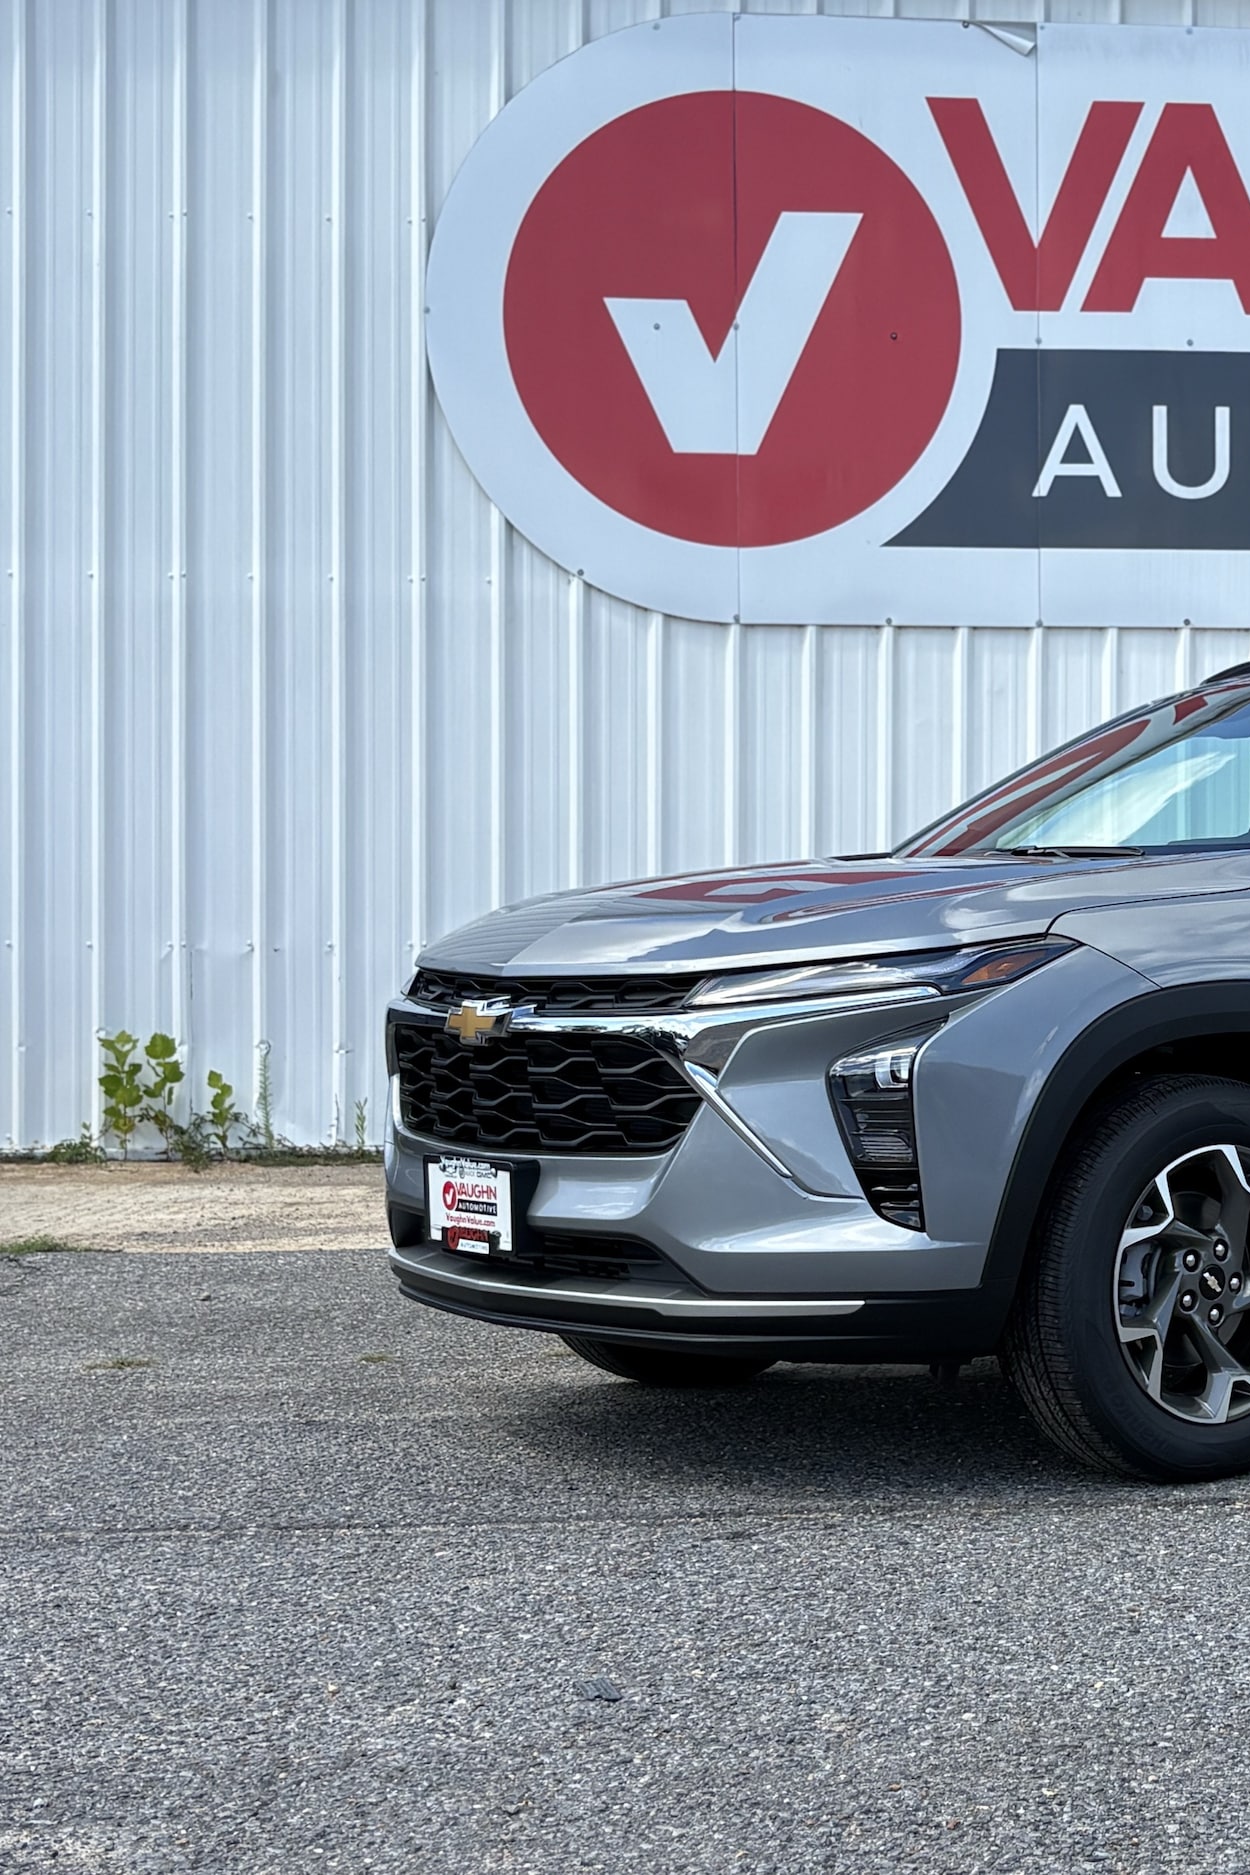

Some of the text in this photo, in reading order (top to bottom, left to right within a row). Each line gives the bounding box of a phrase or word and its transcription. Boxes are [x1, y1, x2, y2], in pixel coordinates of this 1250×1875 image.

[456, 1182, 497, 1200] VAUGHN
[459, 1202, 497, 1213] AUTOMOTIVE
[446, 1213, 495, 1227] VaughnValue.com
